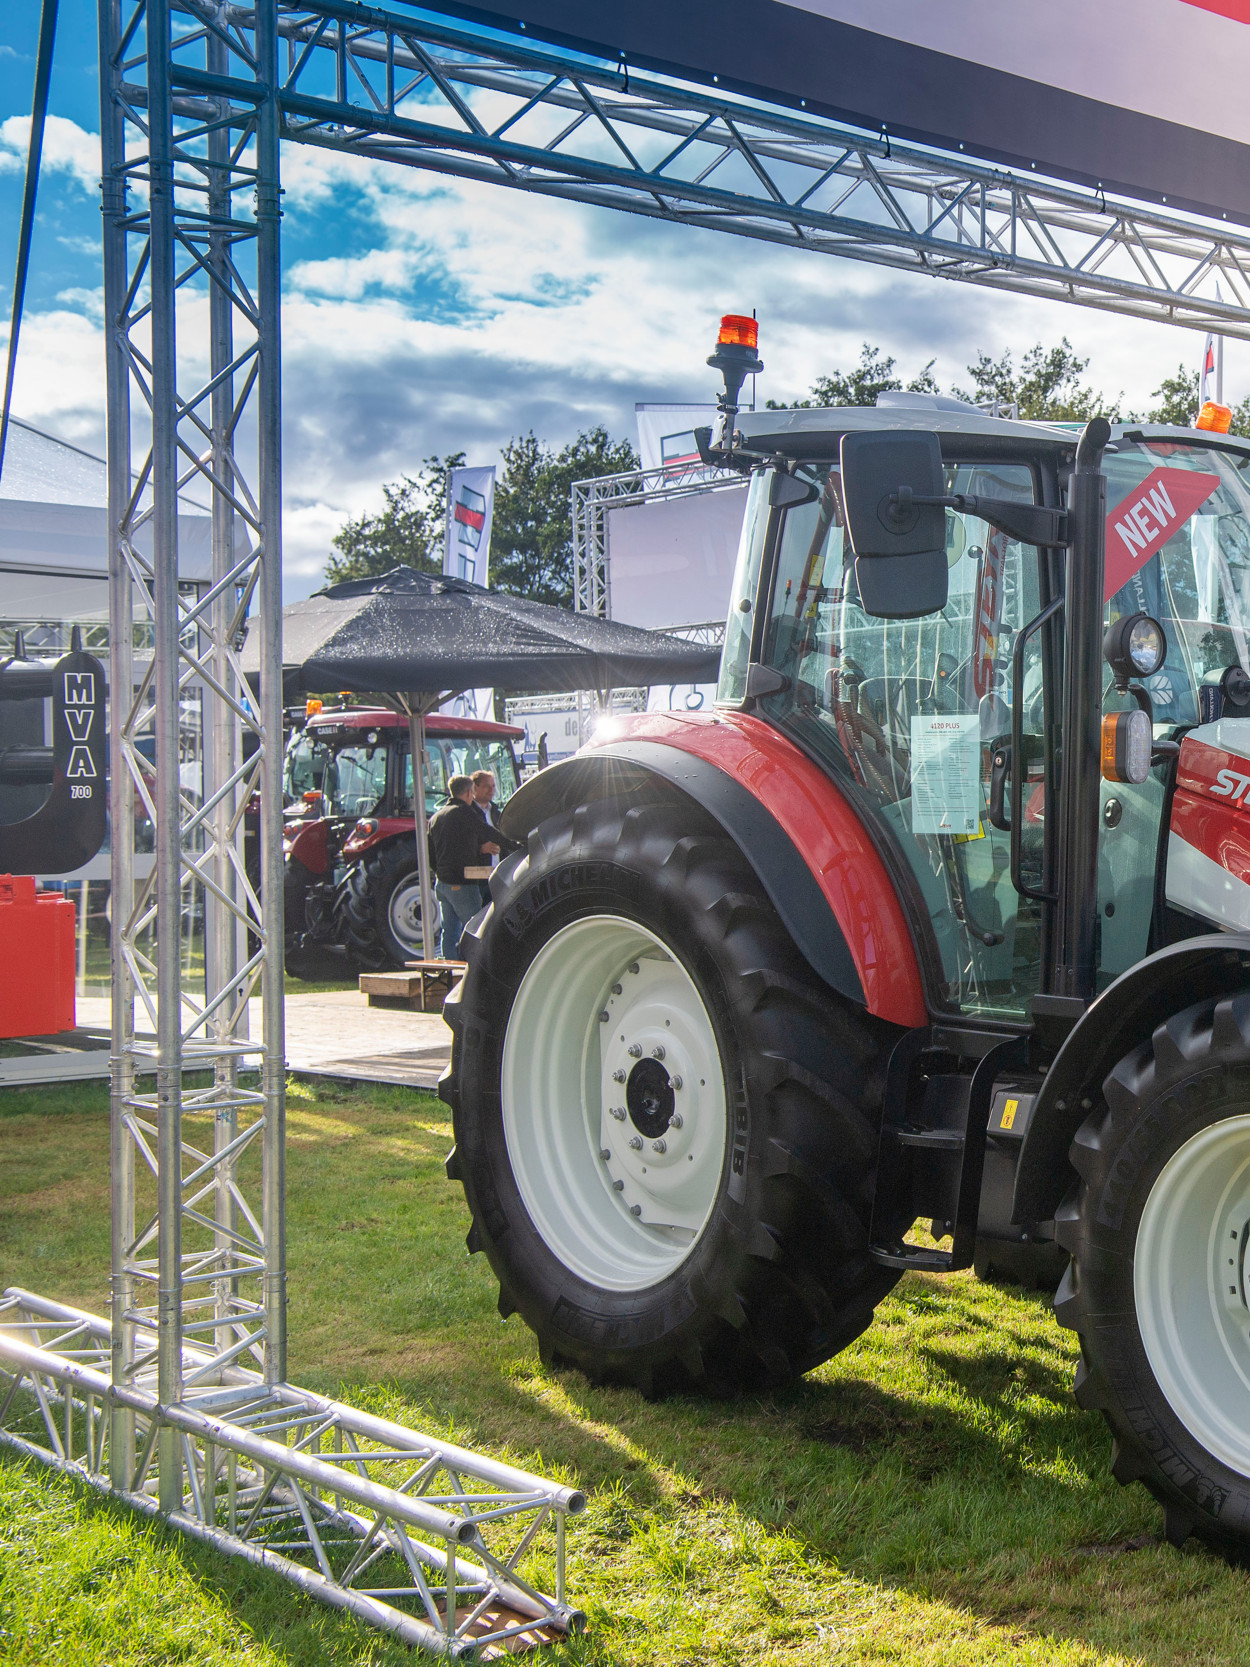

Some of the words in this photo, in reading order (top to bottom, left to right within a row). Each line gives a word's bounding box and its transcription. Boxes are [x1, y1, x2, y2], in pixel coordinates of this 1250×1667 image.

[1113, 479, 1177, 559] NEW
[64, 672, 97, 777] MVA
[317, 727, 333, 736] CASE
[930, 722, 945, 730] 4120
[945, 722, 960, 730] PLUS
[70, 785, 93, 799] 700
